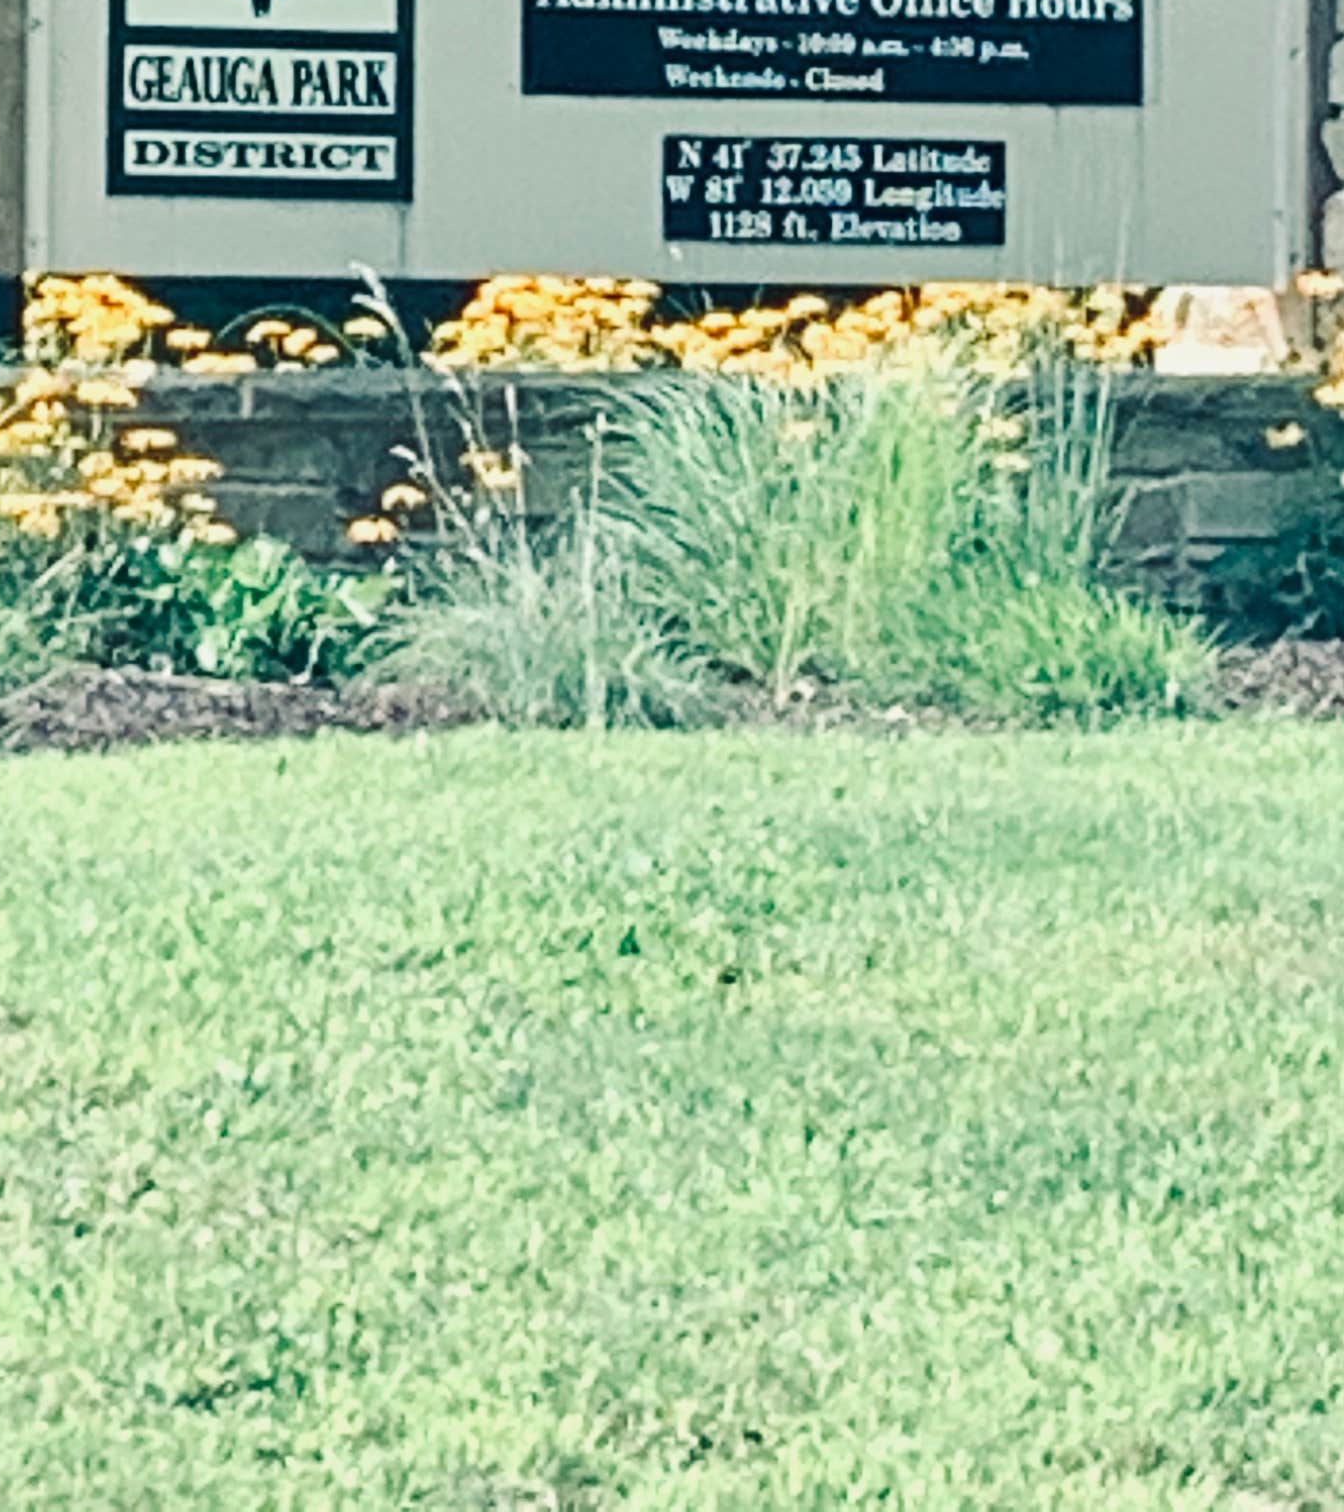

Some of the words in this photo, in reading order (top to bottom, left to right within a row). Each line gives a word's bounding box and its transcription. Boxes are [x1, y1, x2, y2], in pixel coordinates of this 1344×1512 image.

[658, 26, 778, 57] Weekdays
[129, 55, 279, 105] GEAUGA
[290, 58, 390, 108] PARK
[664, 64, 786, 90] Weekends
[805, 67, 885, 92] Closed
[132, 139, 390, 172] DISTRICT
[677, 140, 702, 168] N
[873, 143, 992, 173] Latitude
[666, 175, 695, 203] W
[863, 178, 1005, 212] Longitude
[709, 209, 772, 238] 1128
[782, 210, 819, 241] ft.
[830, 211, 962, 242] Elevation
